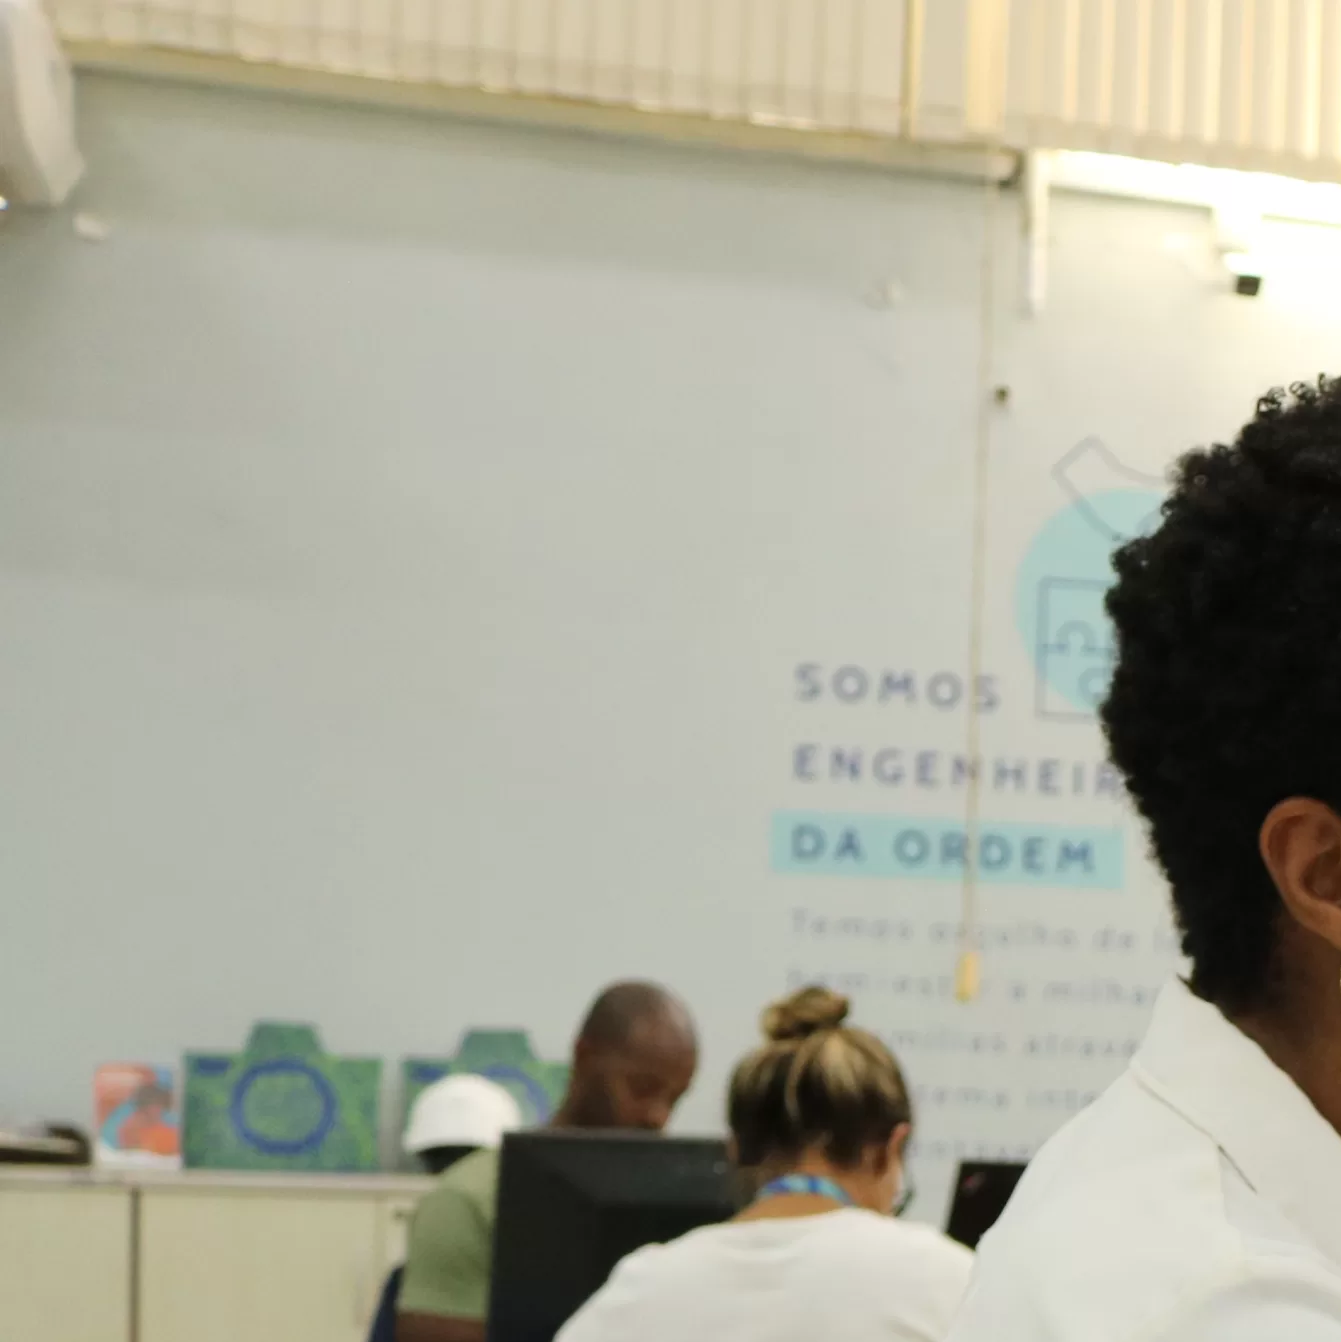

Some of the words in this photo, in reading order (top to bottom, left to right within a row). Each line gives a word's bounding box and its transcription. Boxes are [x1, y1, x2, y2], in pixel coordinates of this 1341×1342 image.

[794, 662, 1001, 714] SOMOS
[791, 823, 867, 865] DA
[892, 828, 1096, 874] ORDEM
